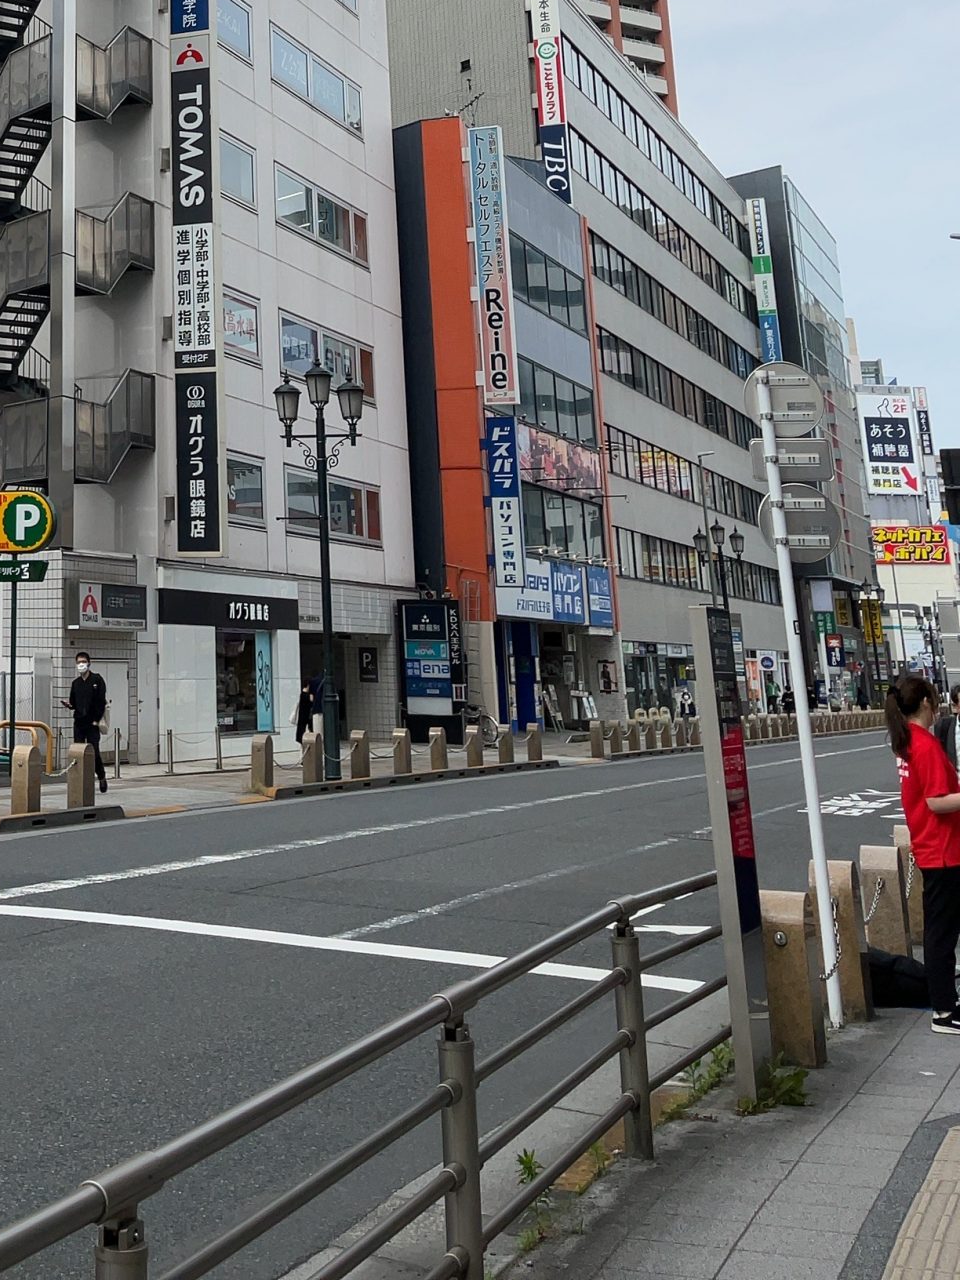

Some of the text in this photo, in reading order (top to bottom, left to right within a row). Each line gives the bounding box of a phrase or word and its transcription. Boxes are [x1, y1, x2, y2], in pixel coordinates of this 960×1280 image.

[543, 62, 557, 121] こどもクラブ
[178, 84, 205, 208] TOMAS
[543, 137, 568, 192] TBC
[176, 229, 192, 347] 進学個別指導
[195, 227, 211, 346] 小学部・中学部・高校部
[485, 288, 508, 389] Reine
[181, 353, 208, 363] 受付2F
[893, 404, 907, 413] 2F
[870, 423, 906, 439] あそう
[920, 412, 928, 432] あそう
[491, 426, 513, 489] ドスパラ
[872, 443, 909, 458] 補聴器
[189, 414, 206, 538] オグラ眼鏡店
[872, 465, 900, 475] 補聴器
[873, 478, 901, 488] 専門店
[16, 504, 40, 540] P
[498, 500, 517, 584] パソコン専門店
[873, 528, 943, 543] ネットカフェ
[894, 545, 946, 560] ポパイ
[554, 593, 582, 615] 専門店
[449, 609, 461, 664] KDX八王子ビル
[363, 652, 372, 668] P
[422, 664, 450, 674] ena
